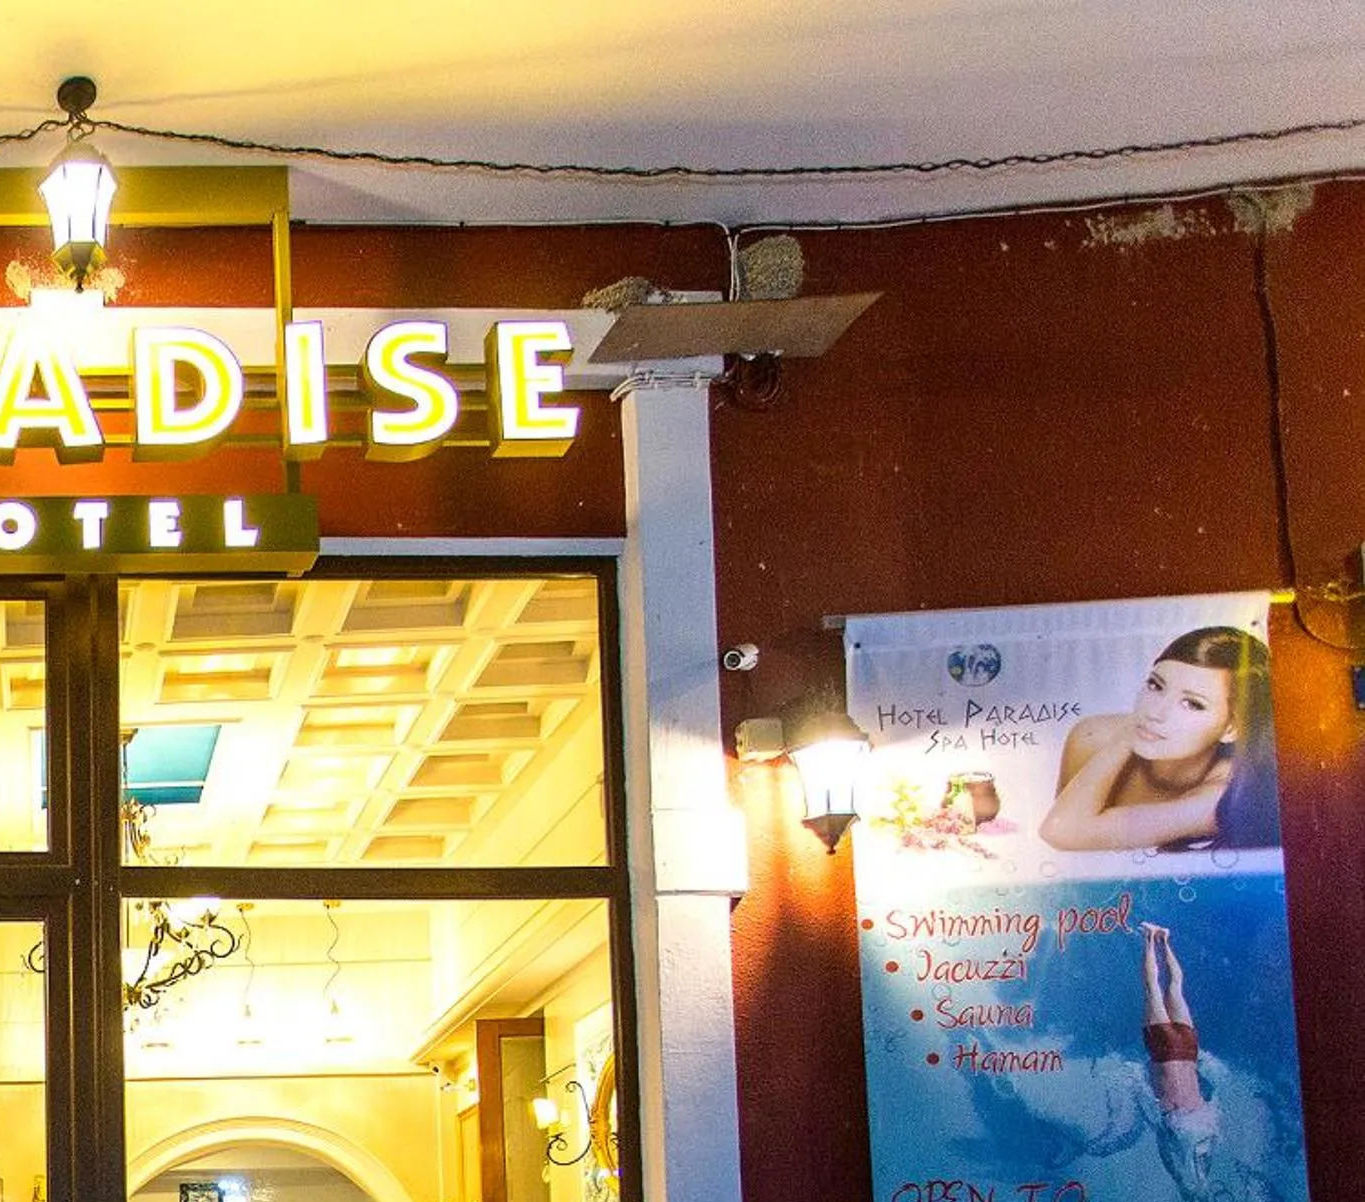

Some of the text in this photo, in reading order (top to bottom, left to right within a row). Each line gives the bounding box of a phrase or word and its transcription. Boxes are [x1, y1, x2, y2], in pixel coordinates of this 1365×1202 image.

[885, 890, 1133, 953] Swimming pool
[916, 949, 1027, 983] Jacuzzi
[935, 996, 1033, 1029] Sauna
[952, 1040, 1064, 1073] Hamam
